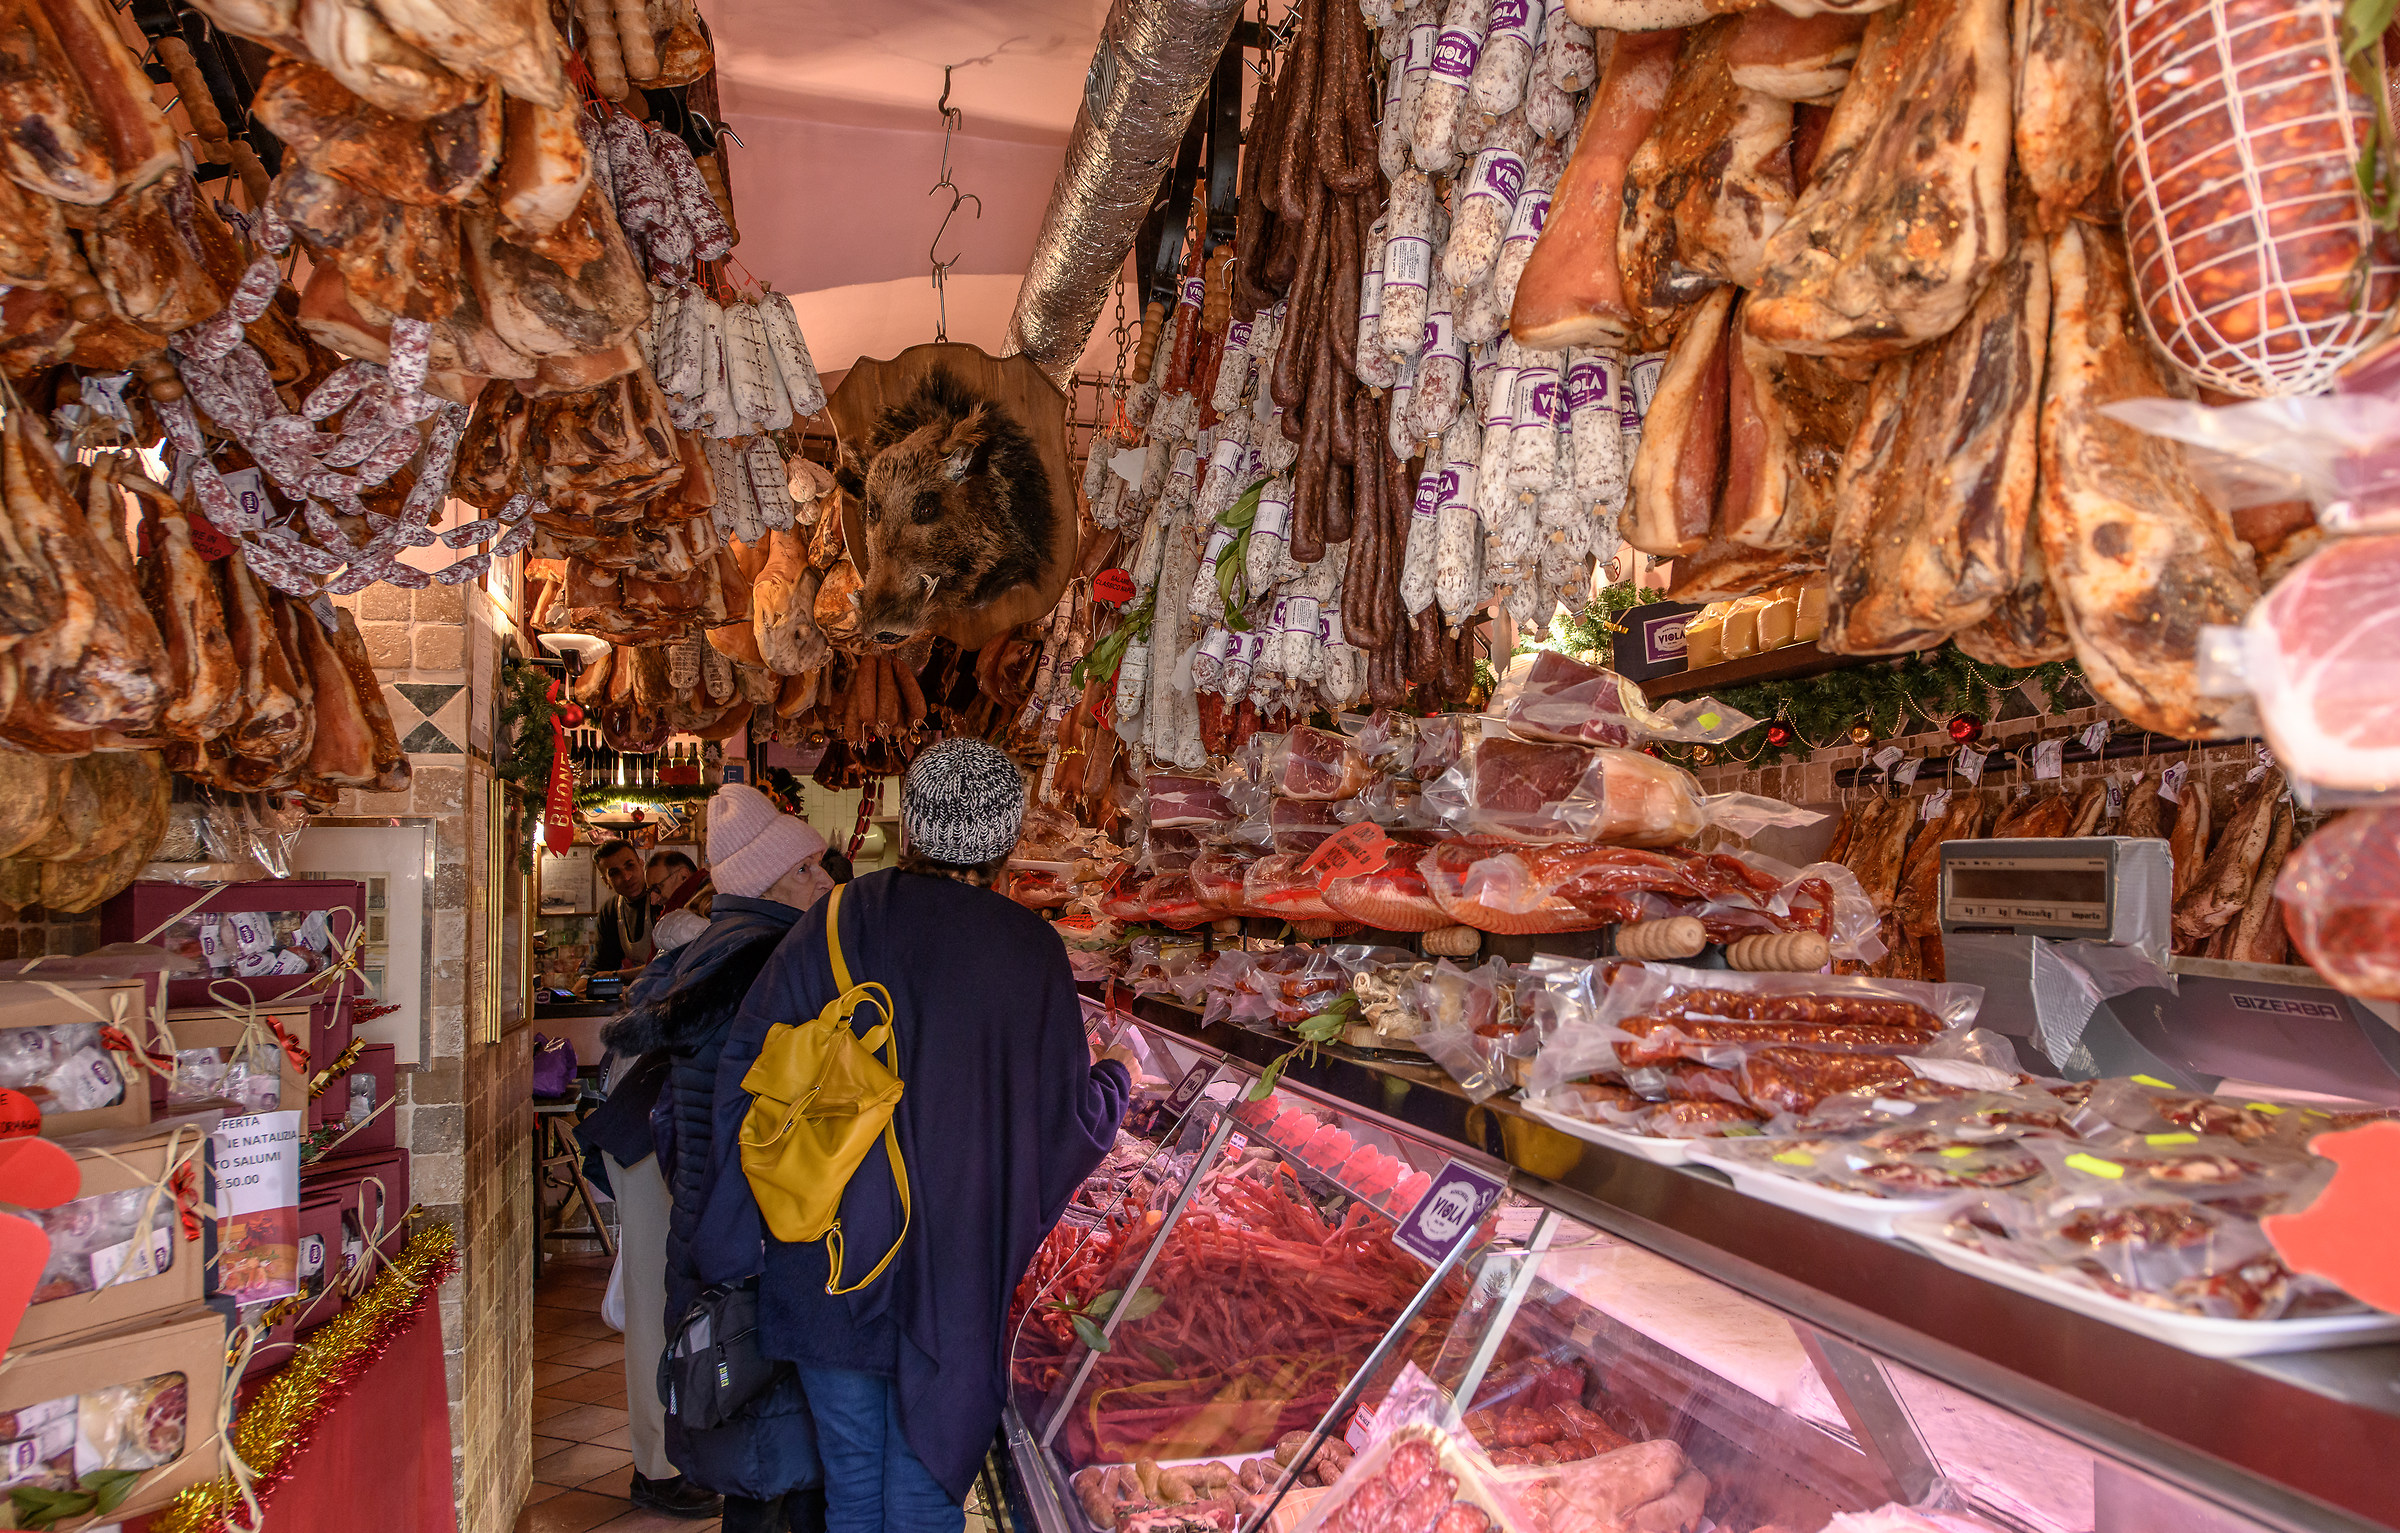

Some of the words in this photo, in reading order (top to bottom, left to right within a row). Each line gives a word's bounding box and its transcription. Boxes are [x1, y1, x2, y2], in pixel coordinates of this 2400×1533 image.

[1434, 45, 1471, 68] VIOLA
[1657, 630, 1686, 645] VIOLA
[1965, 907, 1973, 915] kg
[1999, 908, 2007, 916] kg
[2016, 908, 2052, 918] Prezzo/kg
[2071, 911, 2101, 920] Importo
[2232, 995, 2339, 1019] BIZERBA
[242, 1129, 298, 1147] NATALIZIA
[233, 1151, 281, 1168] SALUMI
[225, 1174, 260, 1189] 50.00
[1430, 1196, 1468, 1227] VIOLA
